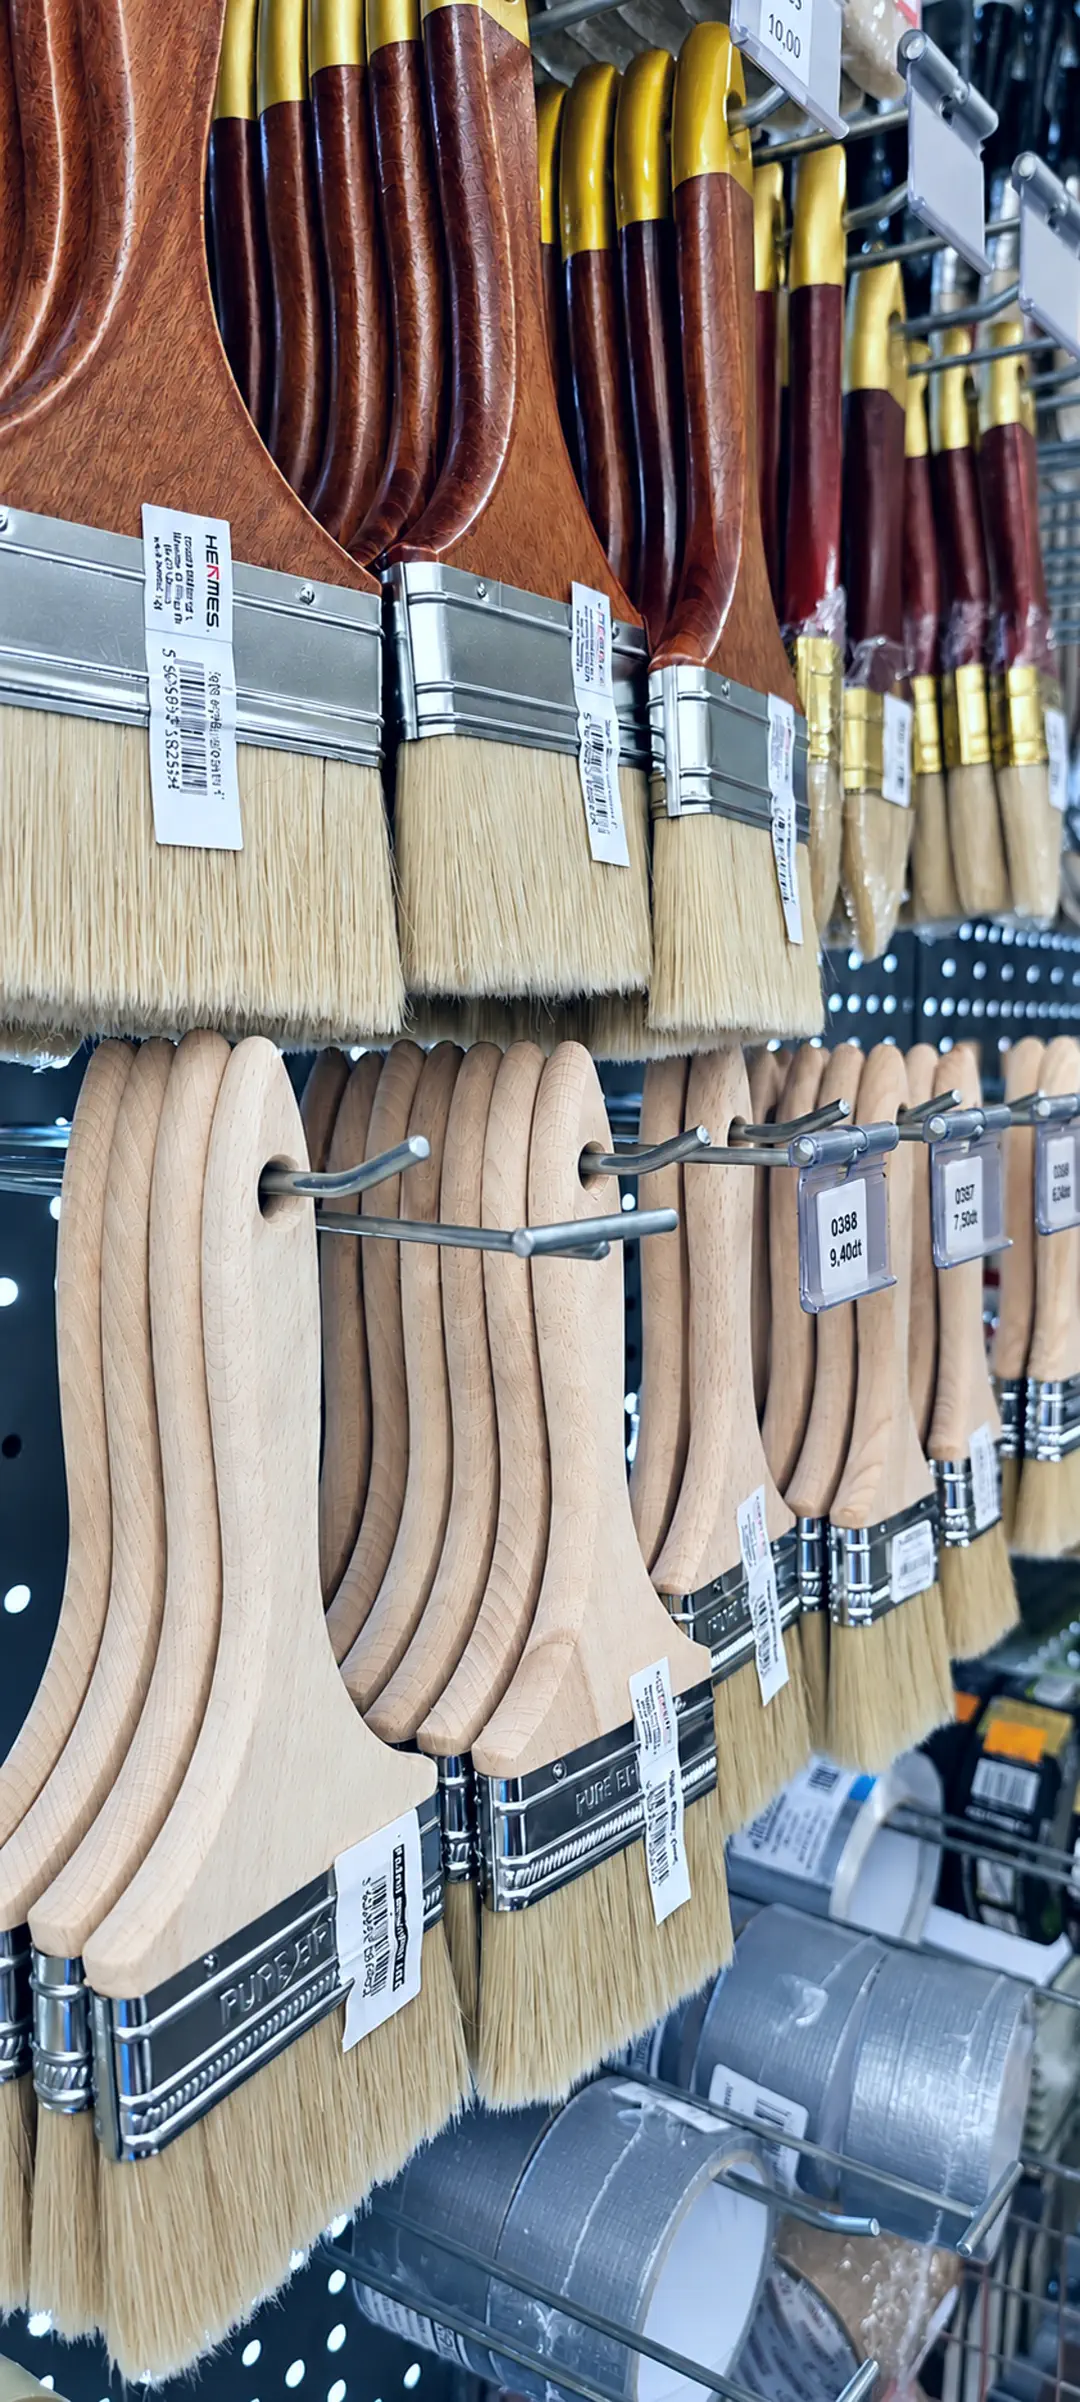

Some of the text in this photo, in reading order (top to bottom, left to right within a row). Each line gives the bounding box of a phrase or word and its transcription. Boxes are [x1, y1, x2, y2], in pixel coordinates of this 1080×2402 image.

[769, 13, 801, 58] 10,00
[204, 534, 221, 629] HERMES
[831, 1211, 858, 1237] 0388
[830, 1239, 862, 1268] 9,40dt
[576, 1775, 612, 1816] PURE
[219, 1949, 288, 2028] PURE
